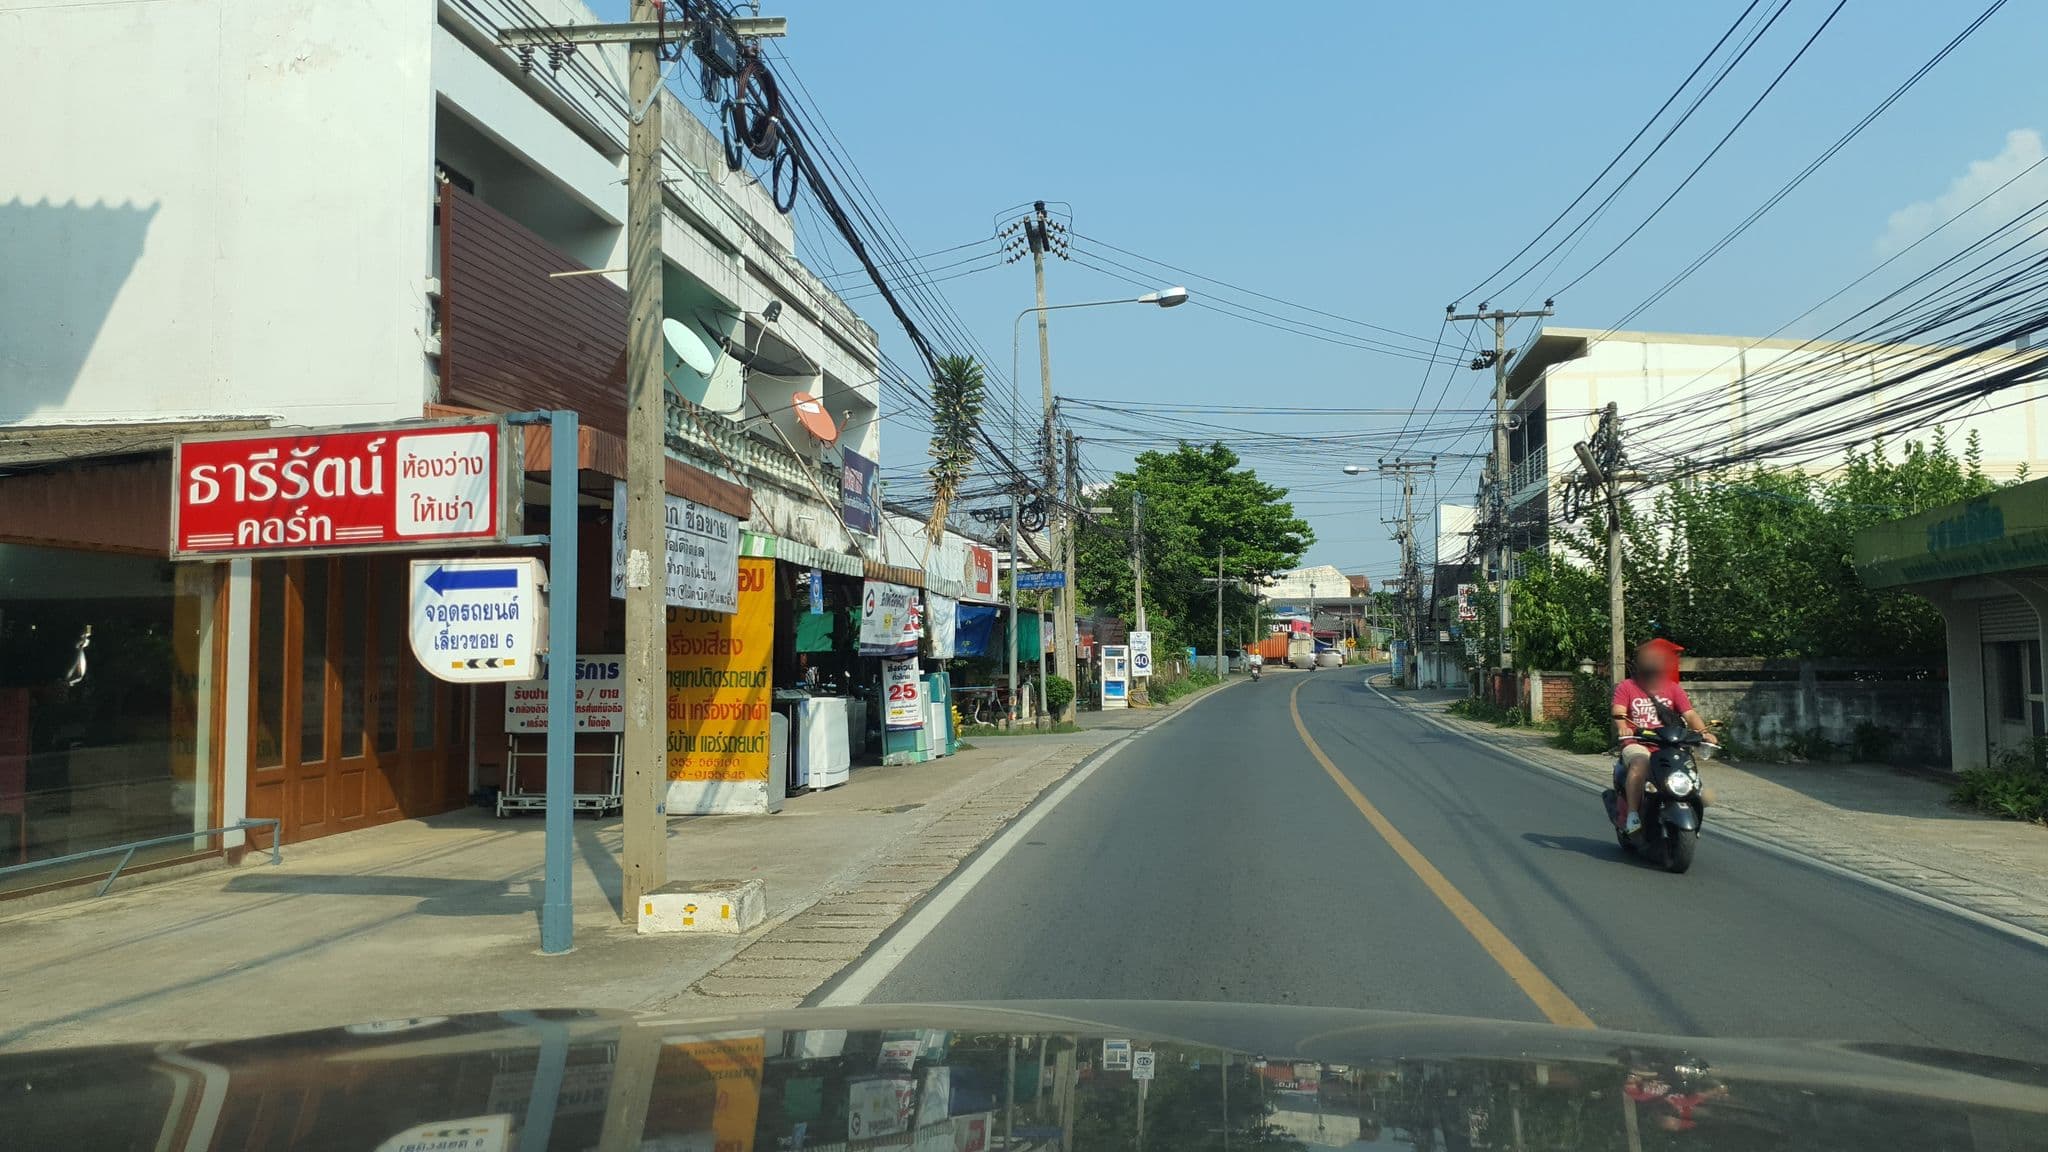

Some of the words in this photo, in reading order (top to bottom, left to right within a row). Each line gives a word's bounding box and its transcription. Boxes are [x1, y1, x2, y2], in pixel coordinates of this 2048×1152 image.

[189, 437, 386, 505] ธารีรัตน์
[403, 451, 483, 479] ห้องว่าง
[410, 493, 473, 522] ให้เช่า
[238, 505, 332, 545] คอร์ท
[425, 595, 519, 622] จอดรถยนต์
[506, 633, 514, 648] 6
[576, 657, 620, 680] ริการ
[1135, 655, 1149, 666] 40
[888, 683, 918, 701] 25
